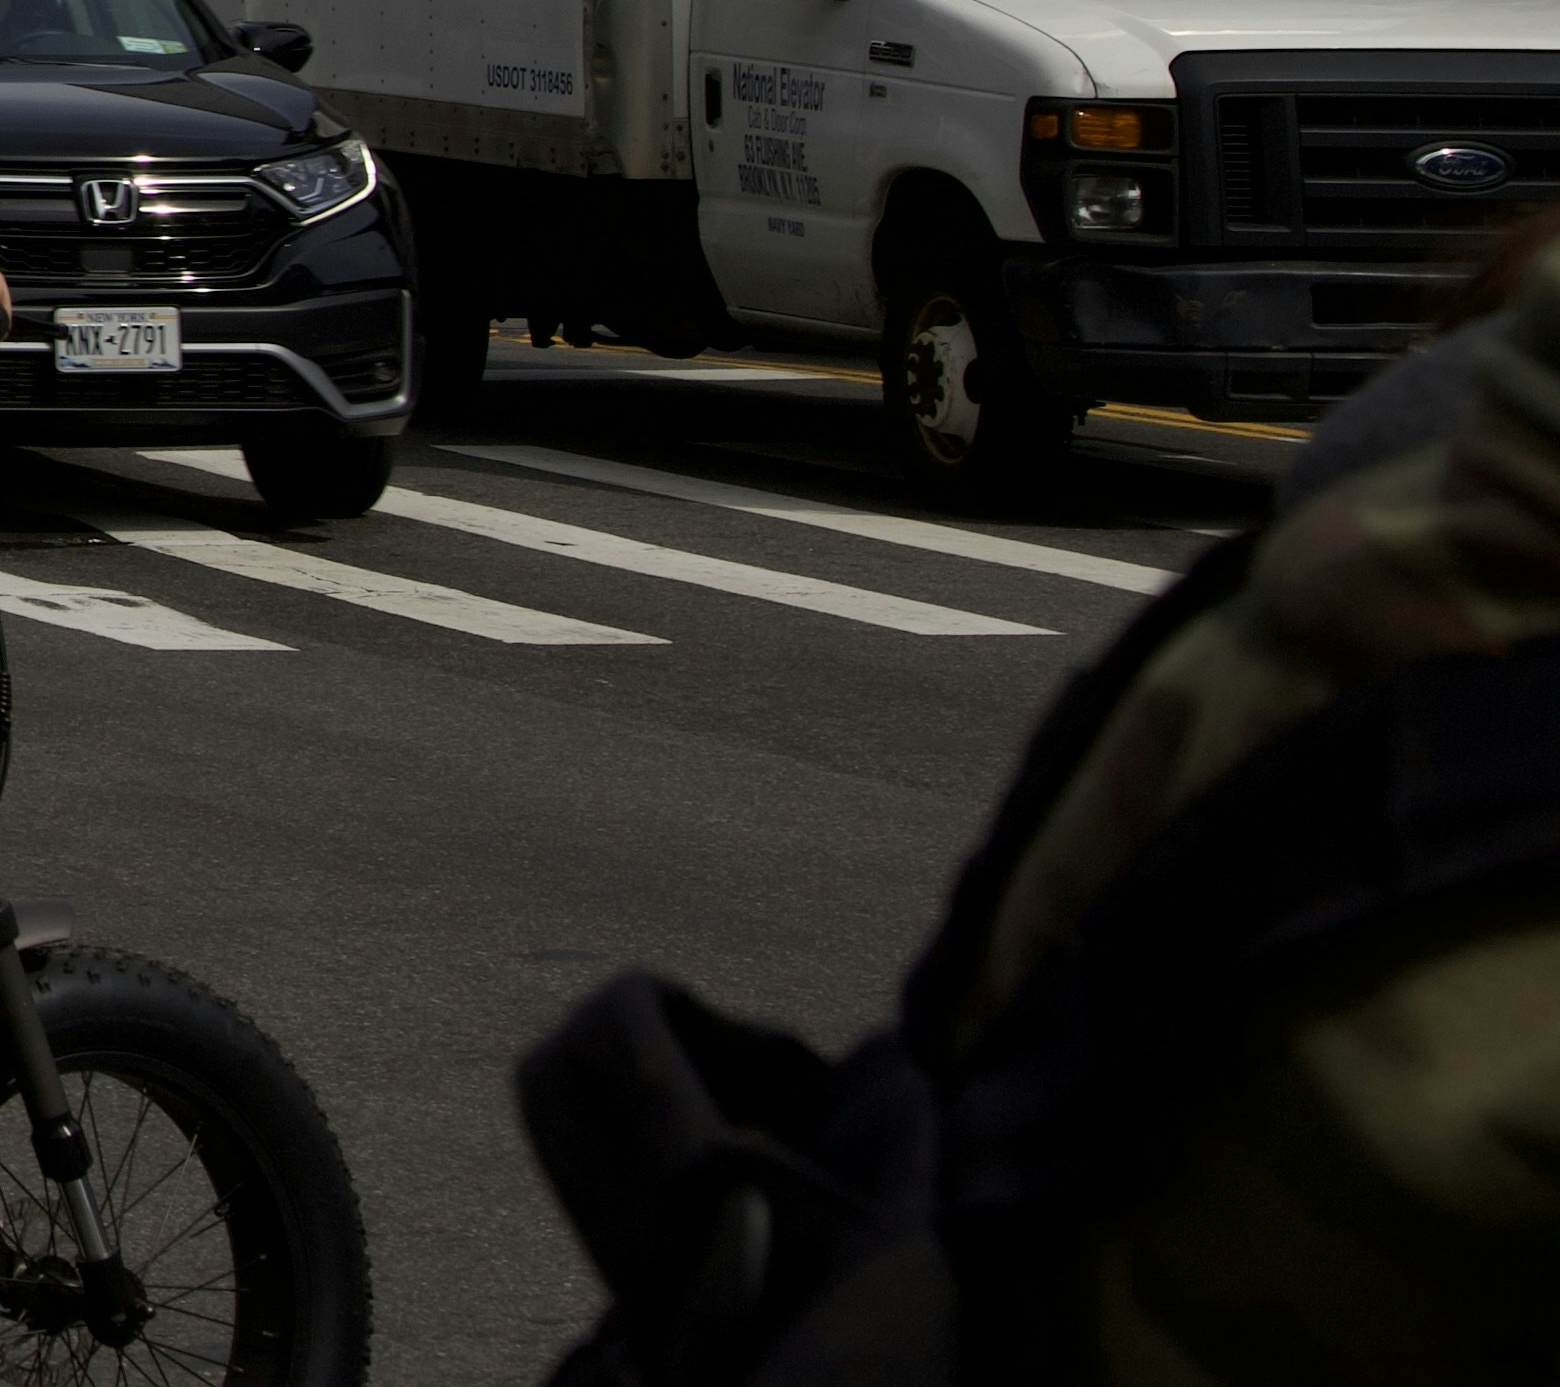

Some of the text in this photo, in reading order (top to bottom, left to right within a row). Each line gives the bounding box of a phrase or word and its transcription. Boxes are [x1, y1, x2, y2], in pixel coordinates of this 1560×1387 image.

[487, 64, 574, 95] USDOT 3118456
[732, 62, 826, 112] National Elevator
[748, 104, 763, 129] Cab
[744, 133, 755, 164] 63
[756, 135, 790, 169] FLUSHING
